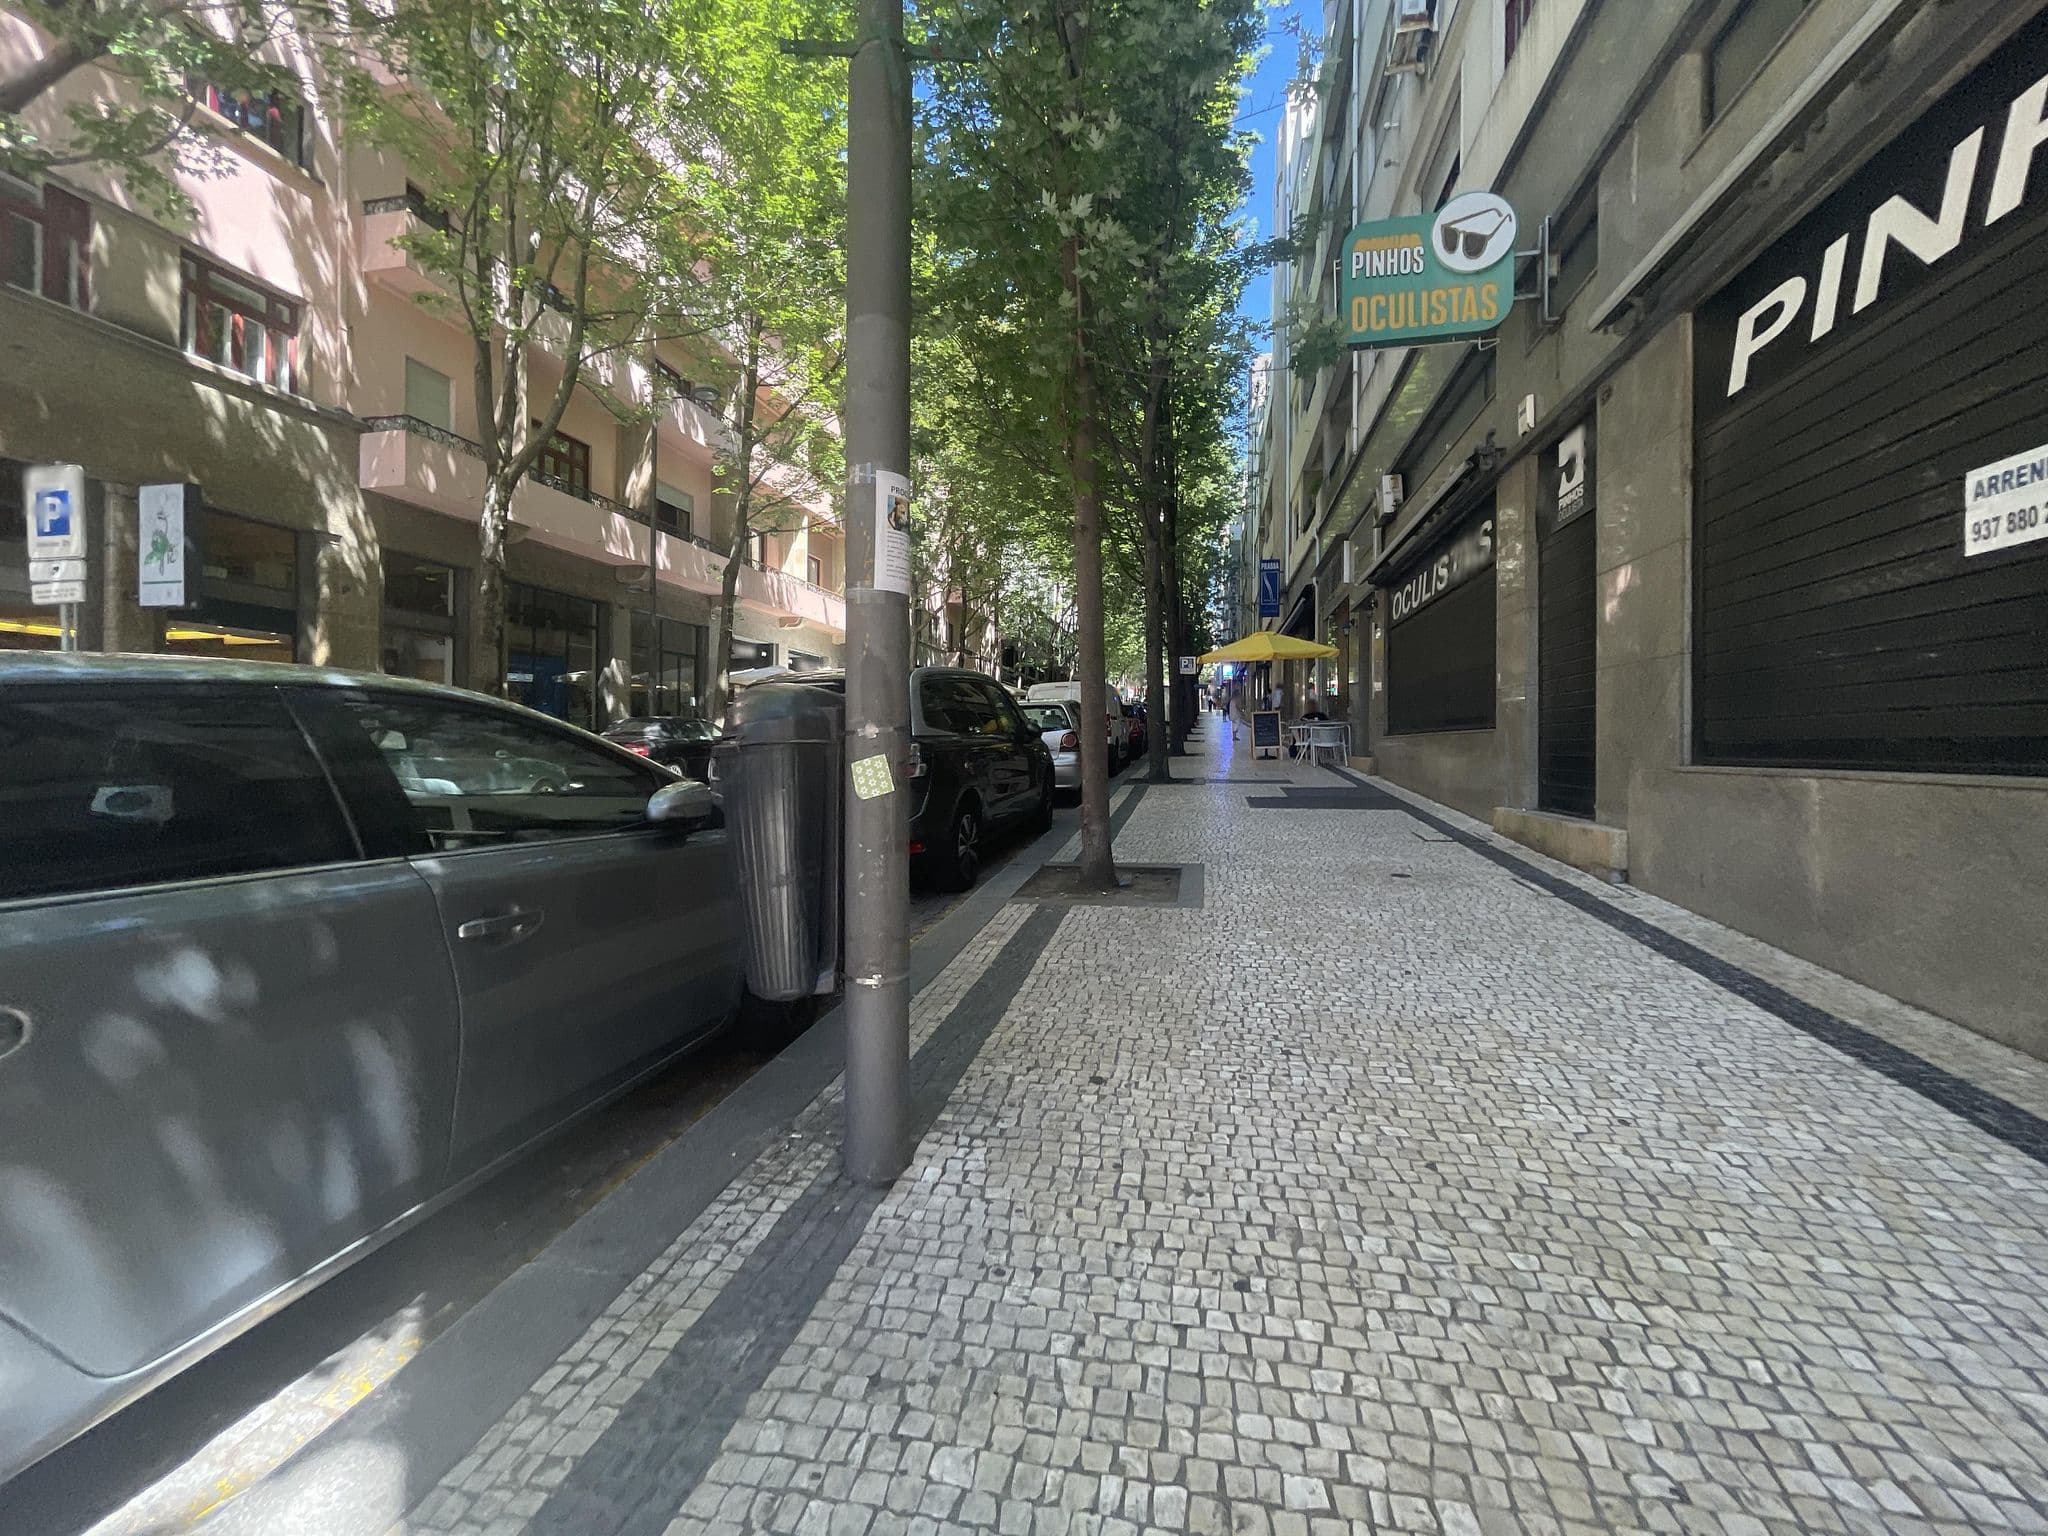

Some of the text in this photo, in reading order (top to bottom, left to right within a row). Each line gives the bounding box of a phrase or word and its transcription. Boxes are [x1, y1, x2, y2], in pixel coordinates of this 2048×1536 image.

[1352, 246, 1424, 279] PINHOS
[1351, 283, 1498, 332] OCULISTAS
[44, 496, 63, 533] P
[1972, 515, 2001, 542] 937
[2007, 505, 2038, 533] 880
[1392, 519, 1493, 620] OCULISS
